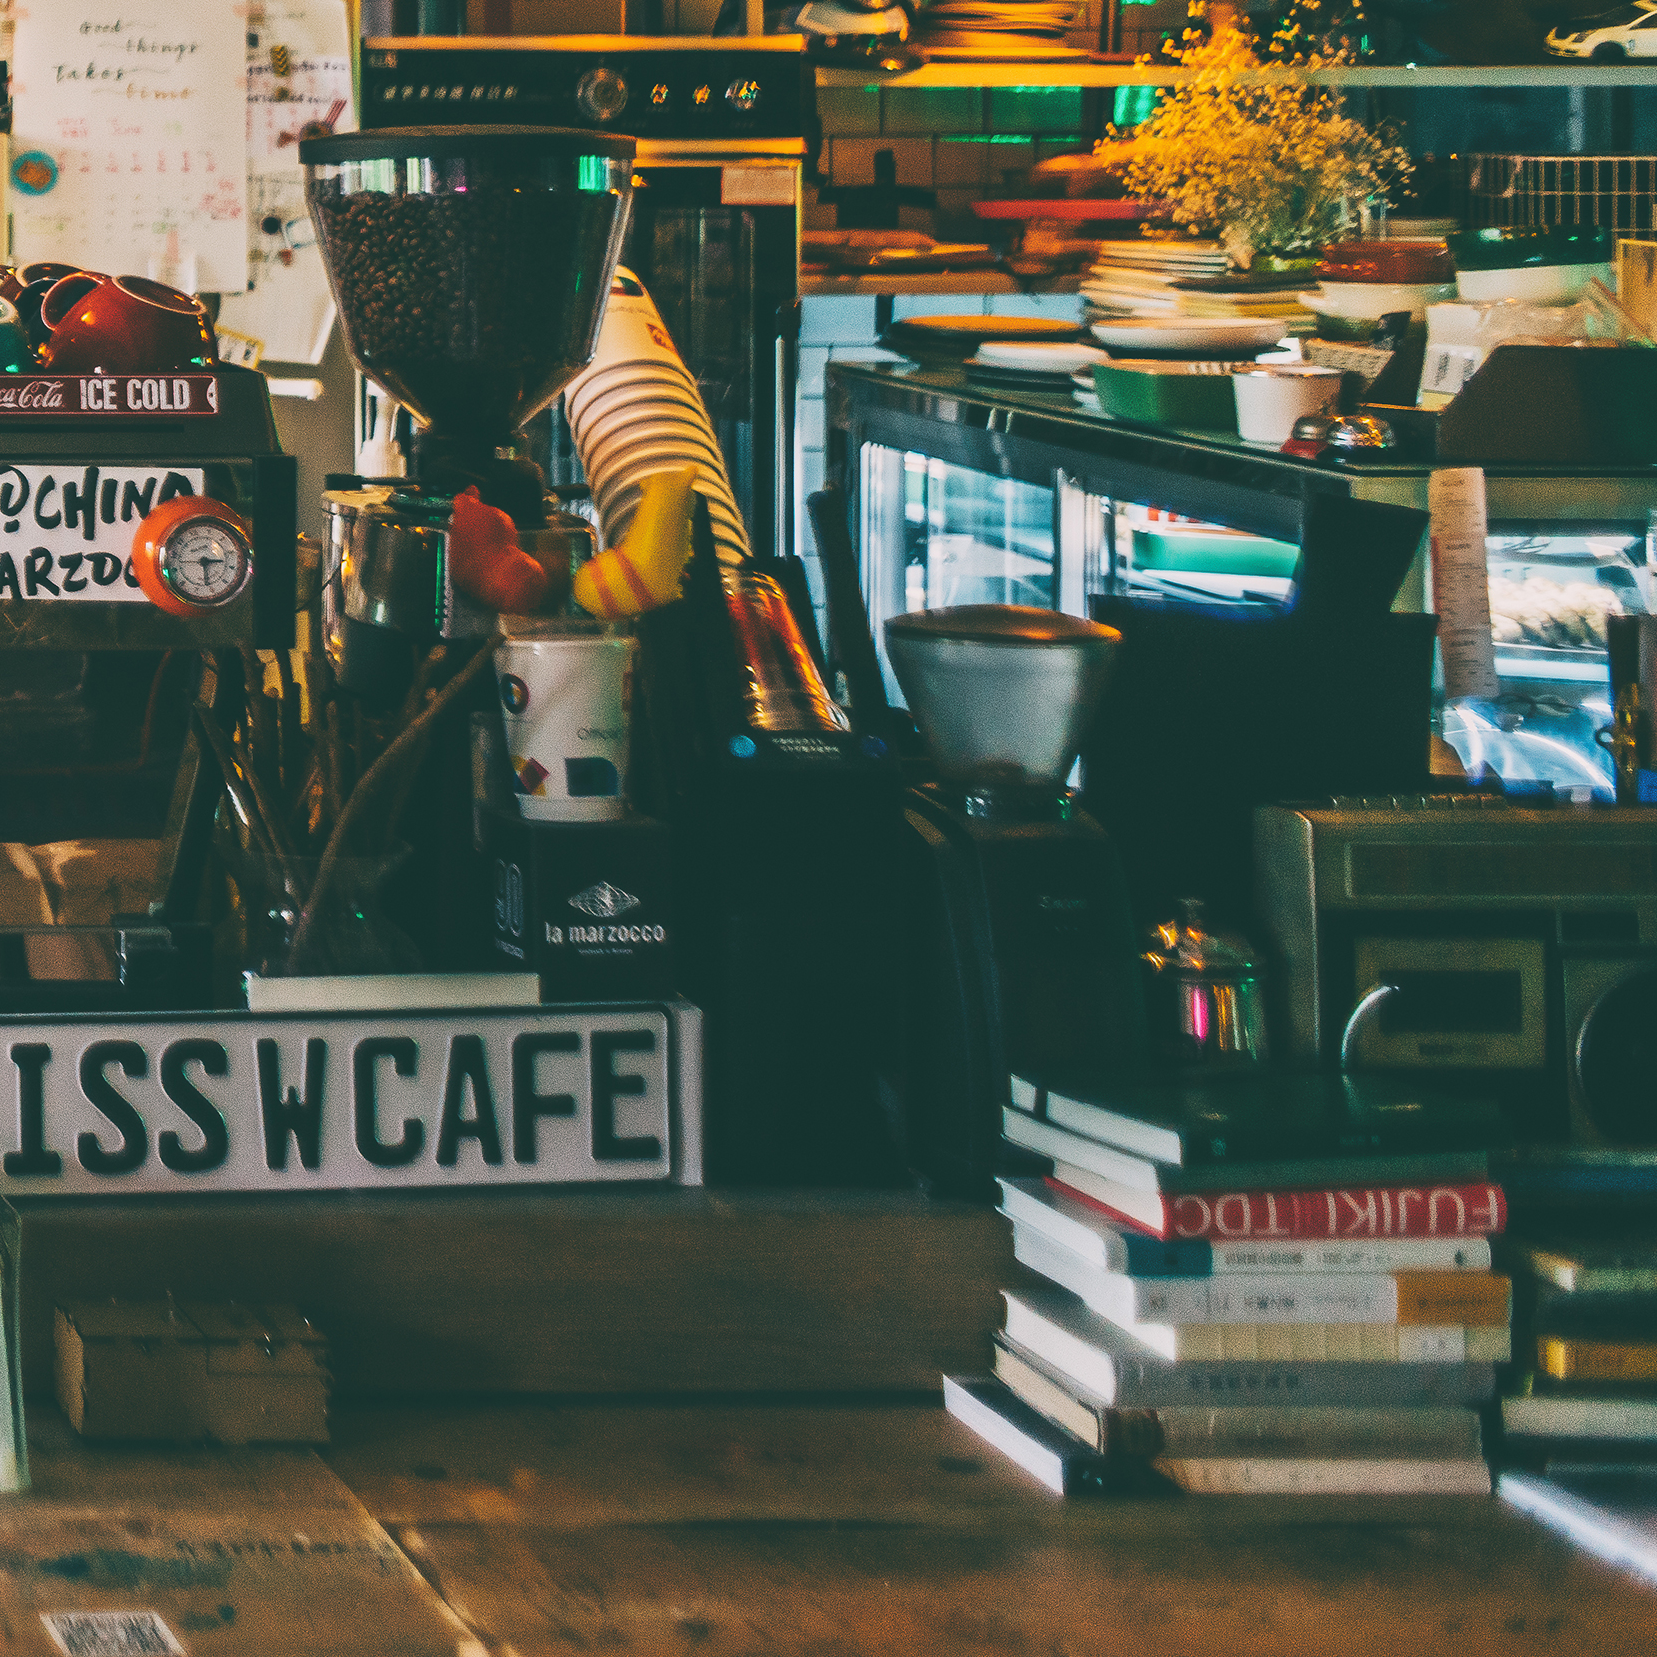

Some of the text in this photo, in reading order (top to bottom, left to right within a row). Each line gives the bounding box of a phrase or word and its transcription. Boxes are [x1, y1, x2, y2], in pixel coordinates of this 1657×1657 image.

[80, 378, 118, 410] ICE
[127, 378, 191, 410] COLD
[544, 920, 667, 944] la marzocco
[1173, 1187, 1499, 1239] FUJIKI TDC
